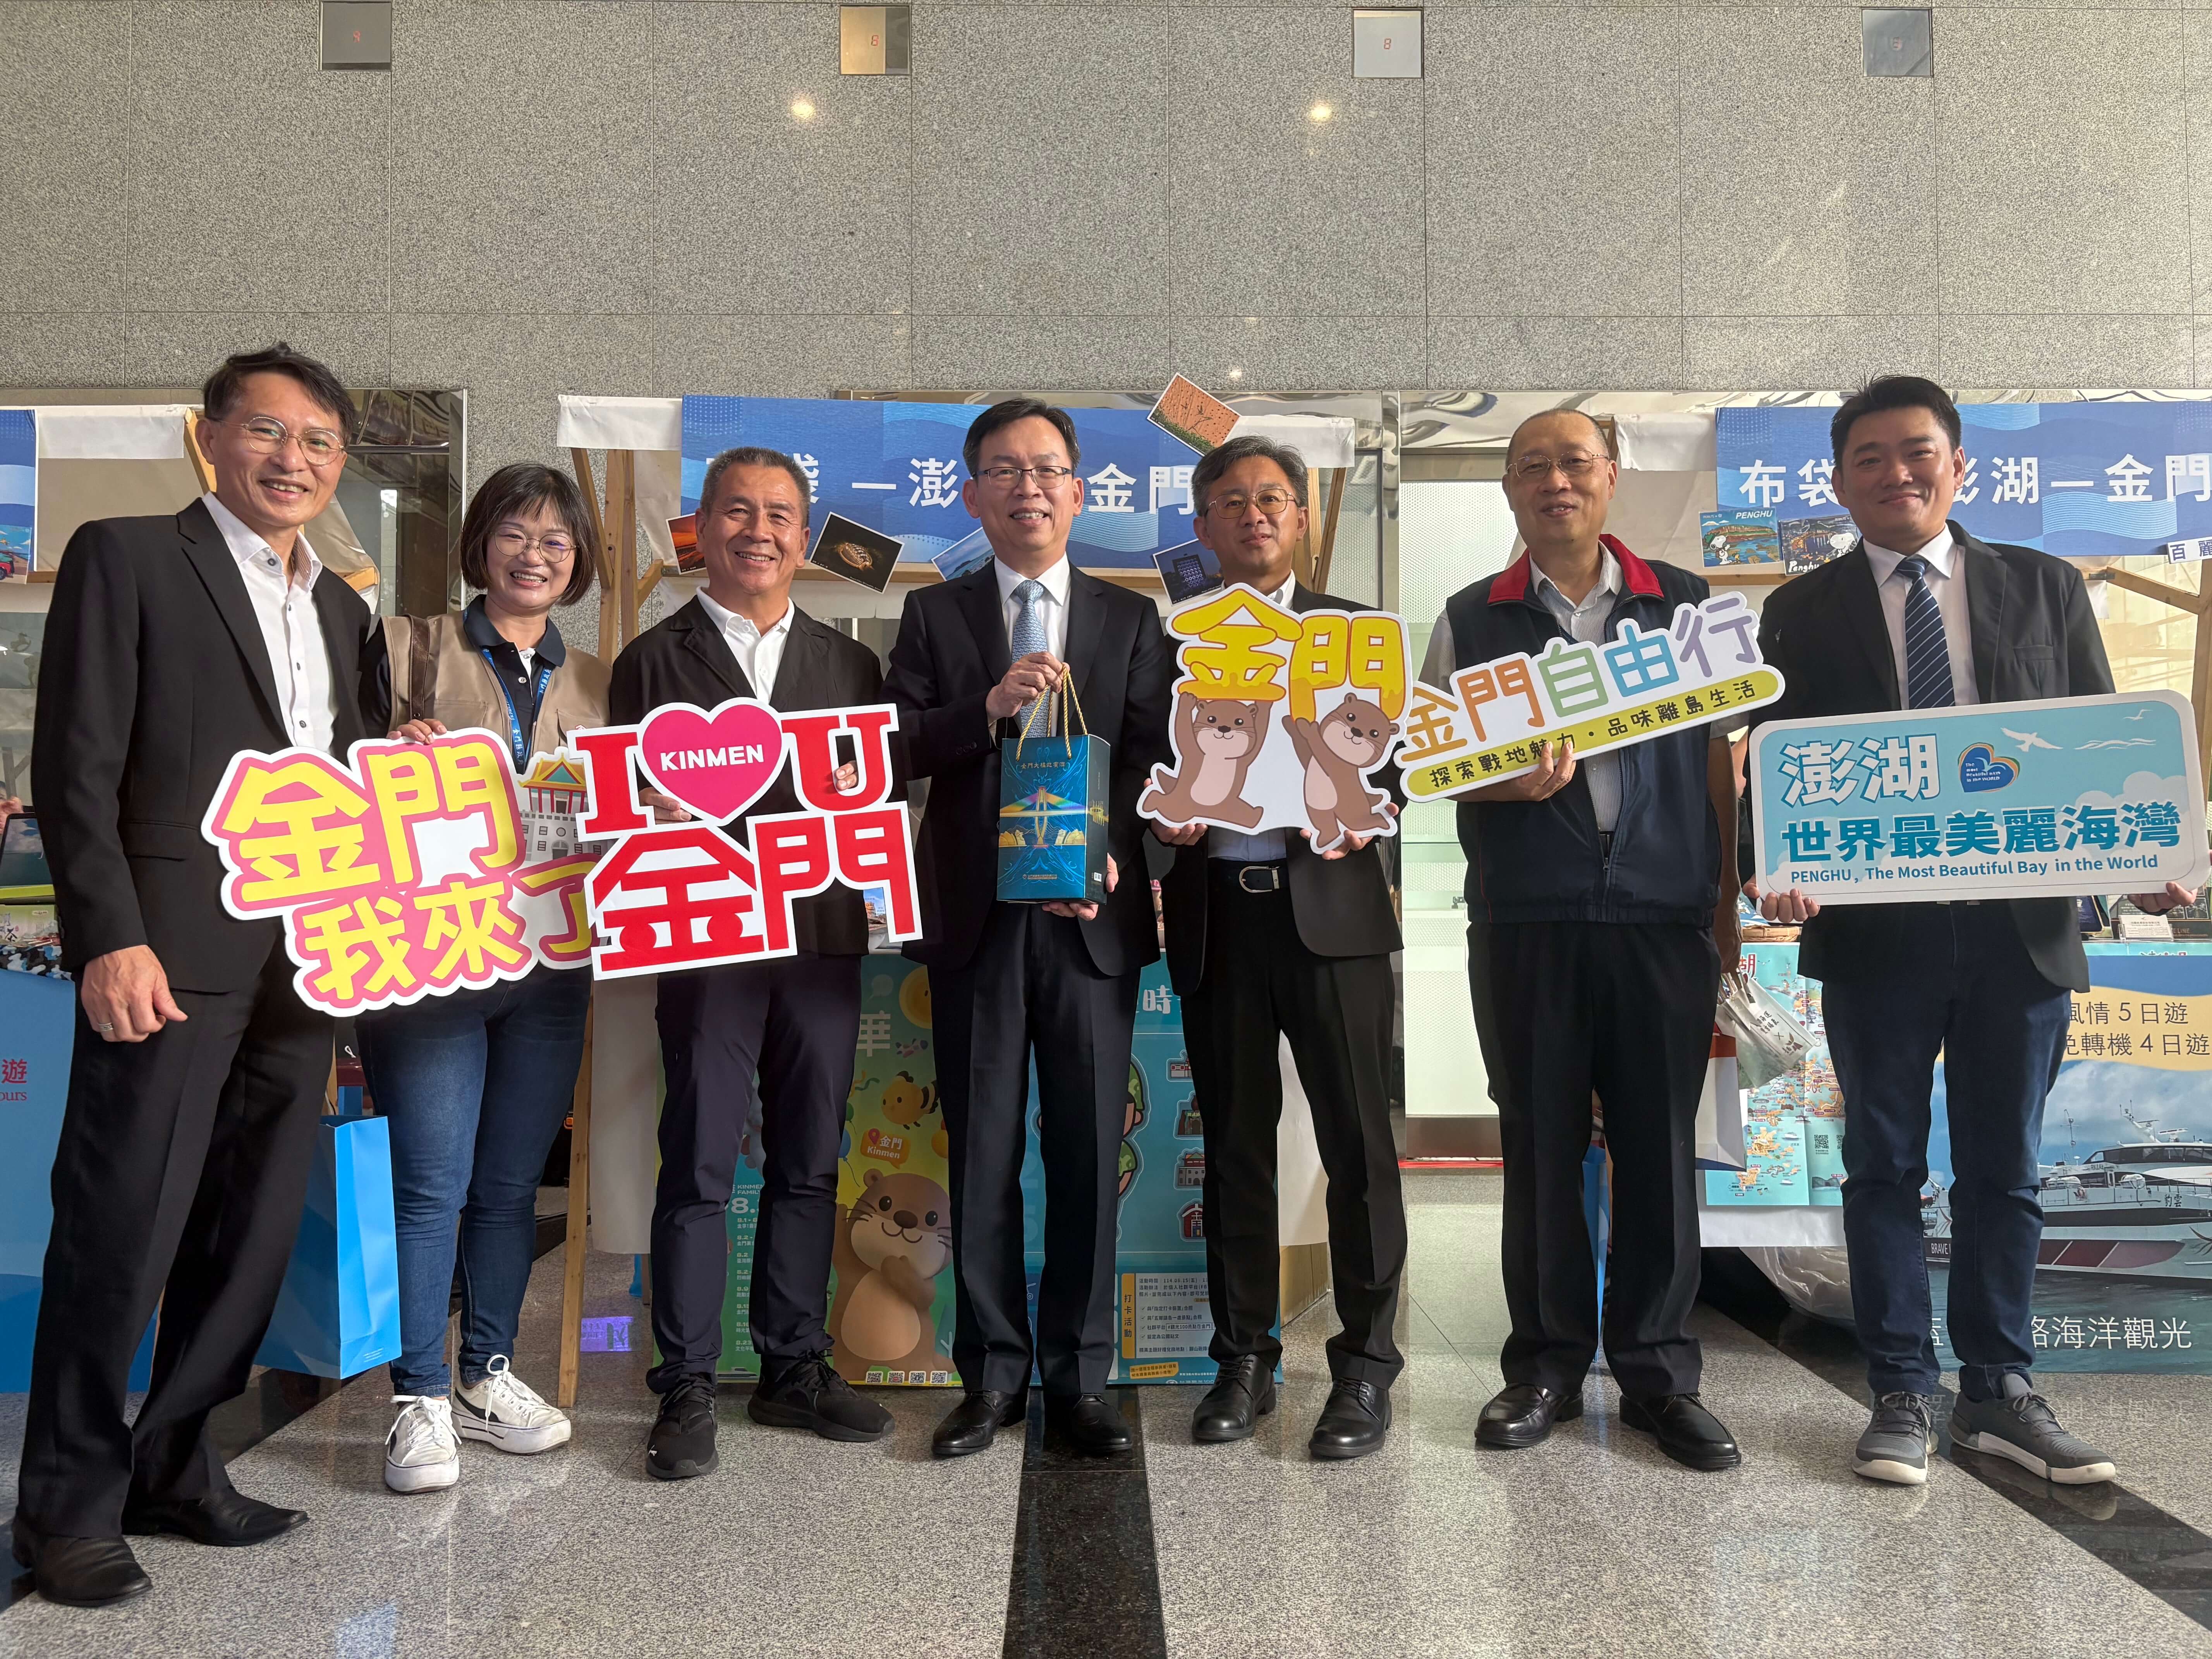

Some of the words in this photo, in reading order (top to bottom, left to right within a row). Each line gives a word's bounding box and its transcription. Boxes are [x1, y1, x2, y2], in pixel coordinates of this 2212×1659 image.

[1384, 38, 1391, 50] 8
[1735, 510, 1773, 520] PENGHU
[1788, 560, 1820, 573] Penghu
[1171, 588, 1406, 722] 金門
[1401, 597, 1758, 762] 金門自由行
[575, 732, 647, 834] I
[660, 744, 764, 771] KINMEN
[781, 711, 891, 811] U
[1779, 733, 1941, 808] 澎湖
[222, 742, 518, 903] 金門
[1781, 800, 2181, 863] 世界最美麗海灣
[1867, 865, 1893, 880] The
[1898, 864, 1935, 878] Most
[1939, 860, 2013, 877] Beautiful
[2017, 860, 2048, 877] Bay
[2055, 857, 2070, 871] in
[2075, 856, 2104, 870] the
[2108, 854, 2158, 869] World
[593, 808, 915, 972] 金門
[302, 860, 598, 1000] 我來了
[1, 1059, 27, 1084] 遊
[867, 1146, 900, 1159] Kinmen
[879, 1135, 903, 1150] 金門
[1930, 1243, 1949, 1255] BRAVE
[1124, 1294, 1132, 1338] 打卡活動
